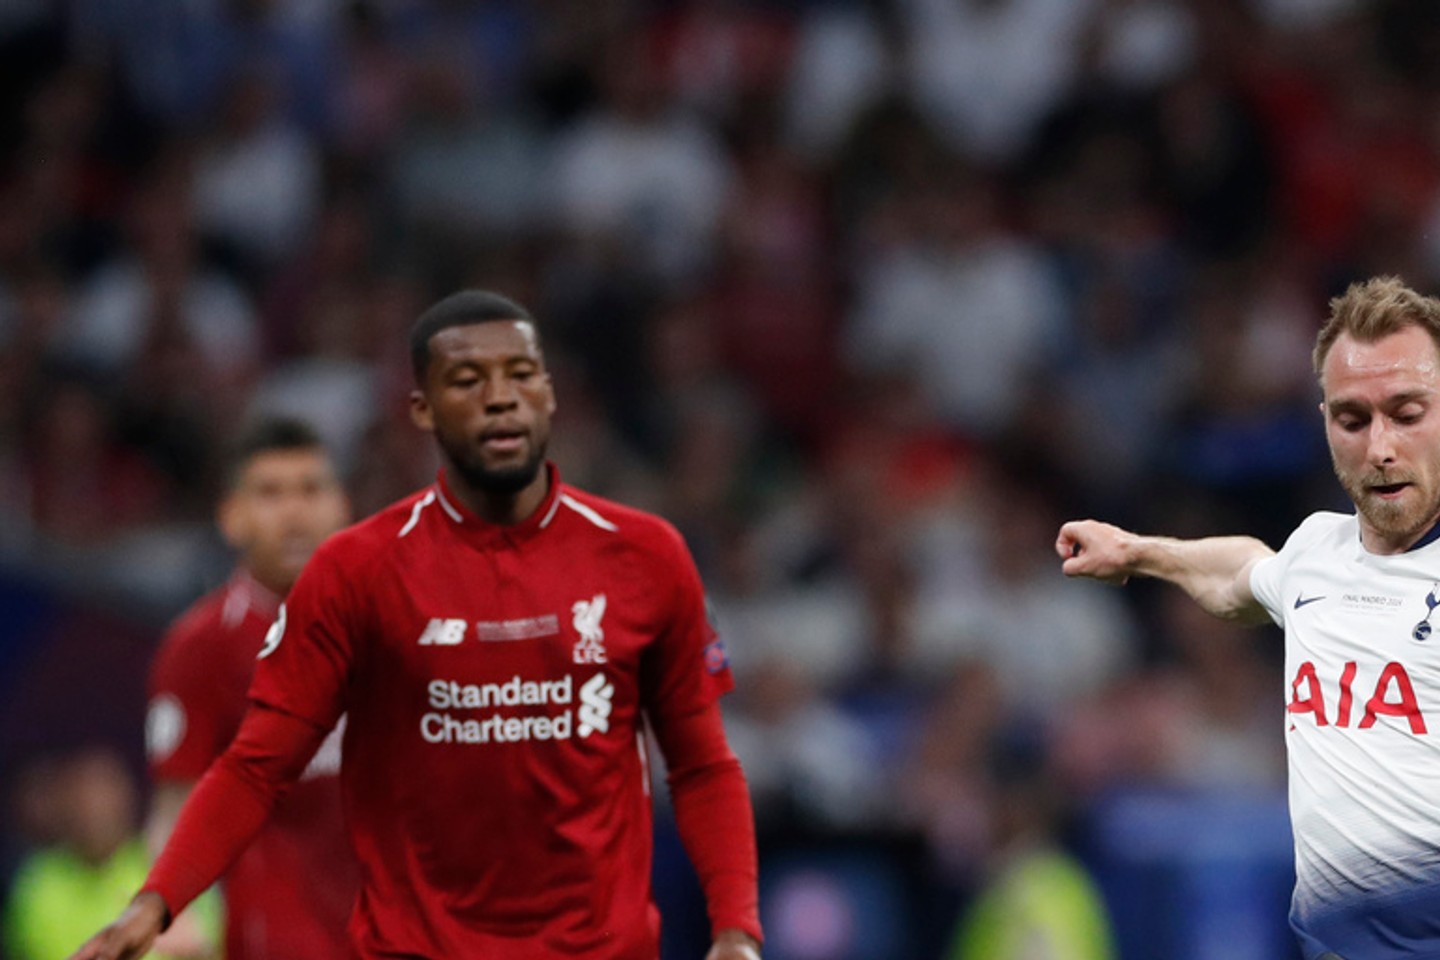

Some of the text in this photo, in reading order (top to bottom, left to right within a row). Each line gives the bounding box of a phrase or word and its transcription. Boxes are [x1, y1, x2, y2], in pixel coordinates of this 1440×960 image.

[573, 644, 608, 665] LFC
[428, 674, 572, 709] Standard
[1287, 660, 1428, 735] AIA
[420, 711, 572, 744] Chartered
